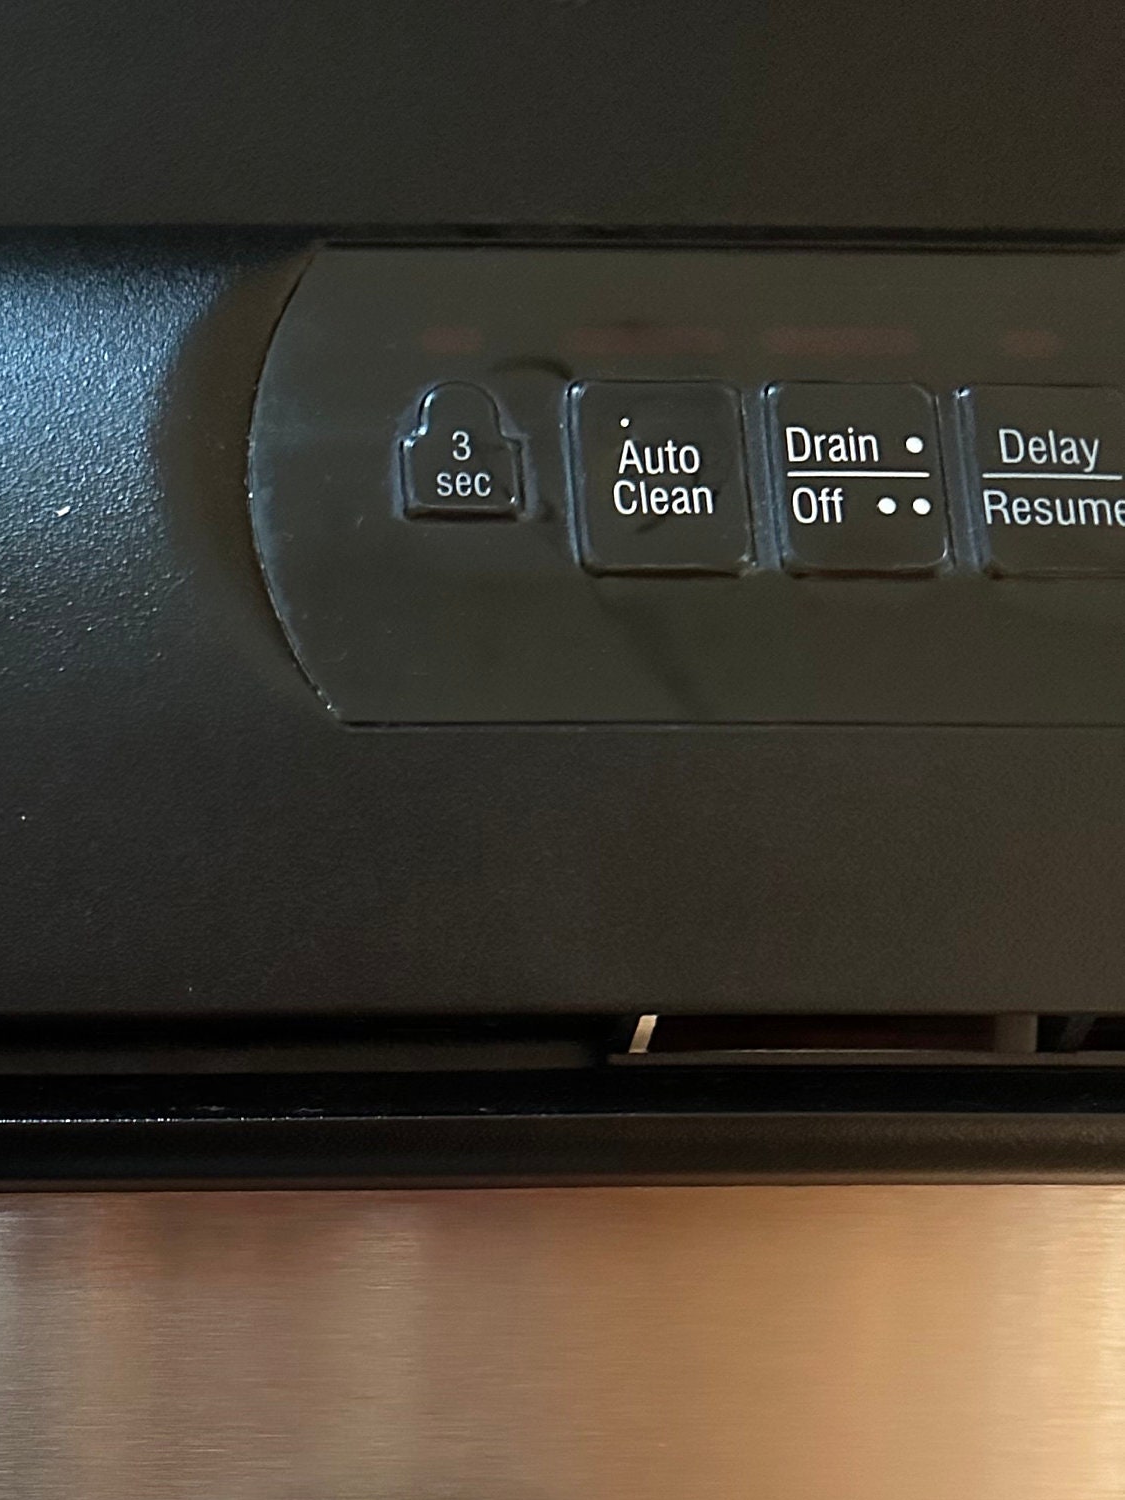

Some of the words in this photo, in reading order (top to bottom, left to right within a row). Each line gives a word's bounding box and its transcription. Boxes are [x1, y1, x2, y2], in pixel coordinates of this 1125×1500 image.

[451, 430, 472, 461] 3
[618, 439, 700, 475] Auto
[785, 426, 879, 463] Drain
[998, 428, 1099, 473] Delay
[436, 471, 492, 497] sec
[613, 480, 714, 515] Clean
[792, 487, 844, 525] Off
